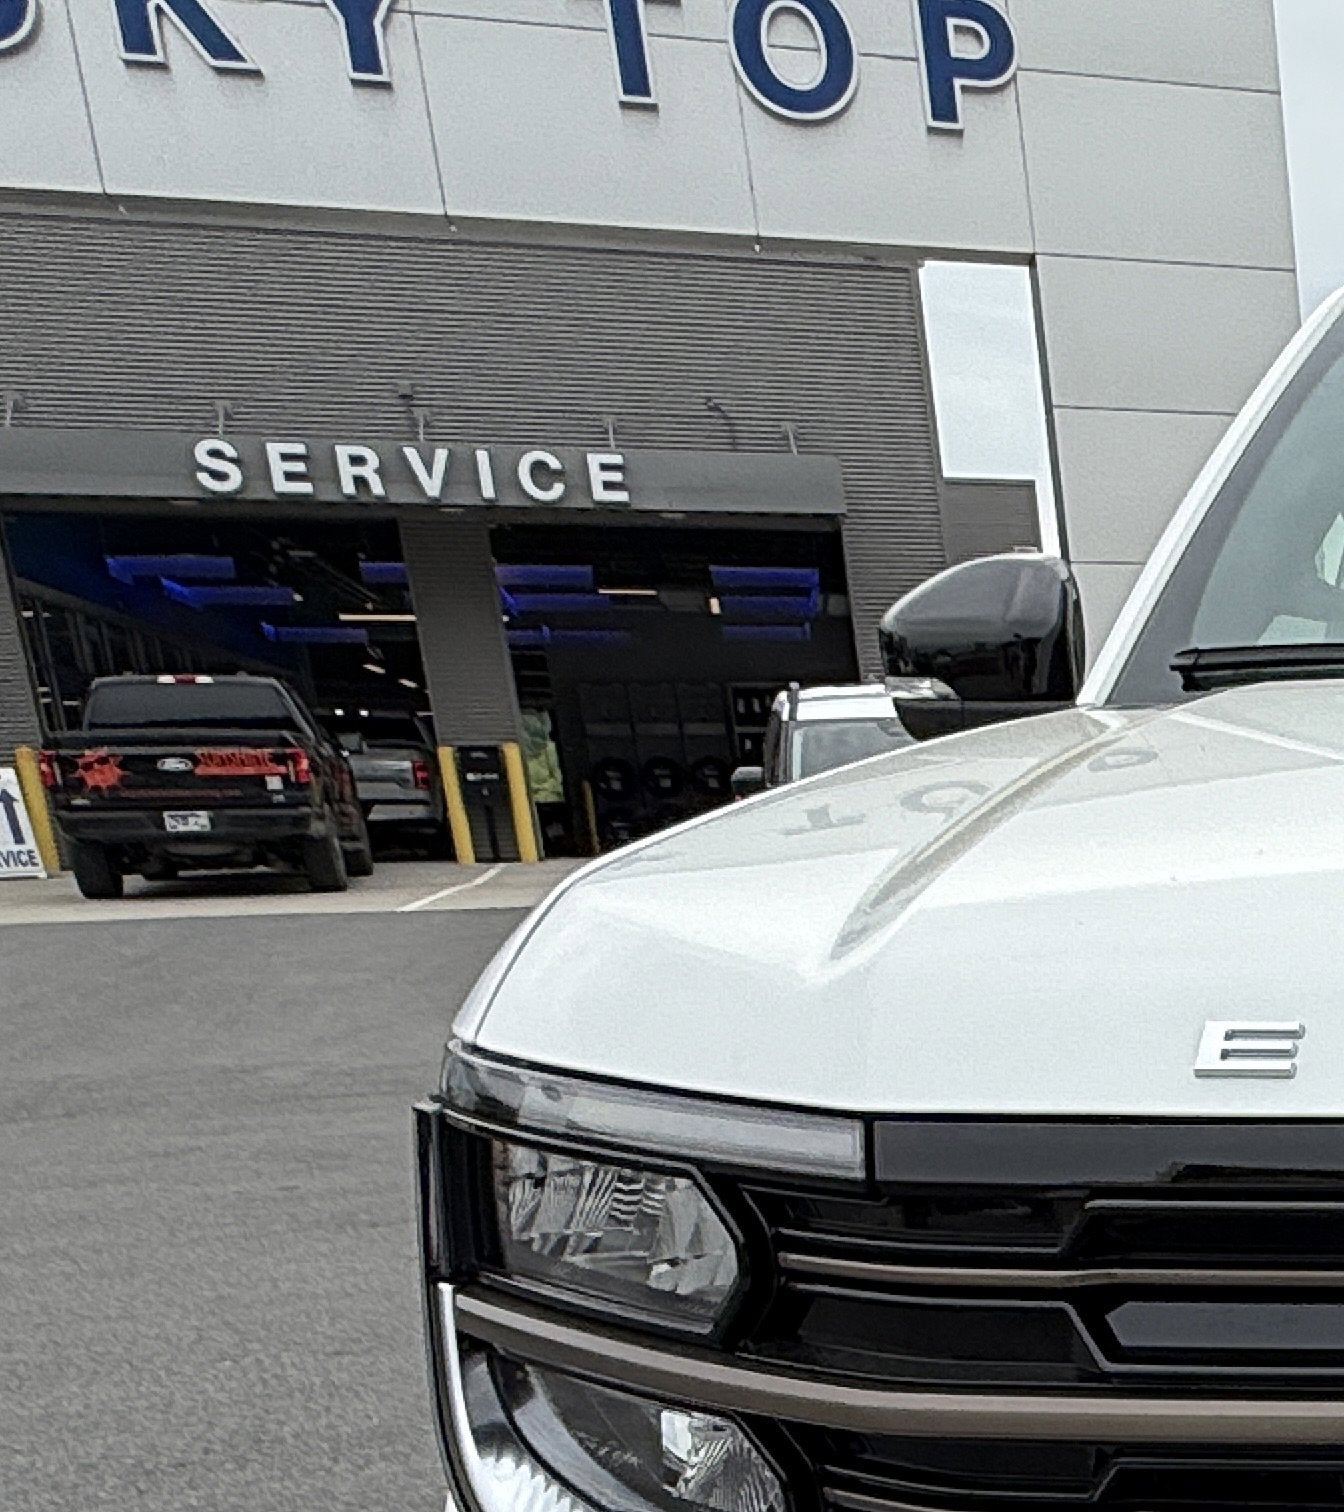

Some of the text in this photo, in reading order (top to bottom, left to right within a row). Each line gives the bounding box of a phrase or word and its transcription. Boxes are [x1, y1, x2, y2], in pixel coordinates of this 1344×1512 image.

[0, 0, 1018, 133] KY TOP
[194, 438, 631, 503] SERVICE
[0, 849, 40, 868] VICE
